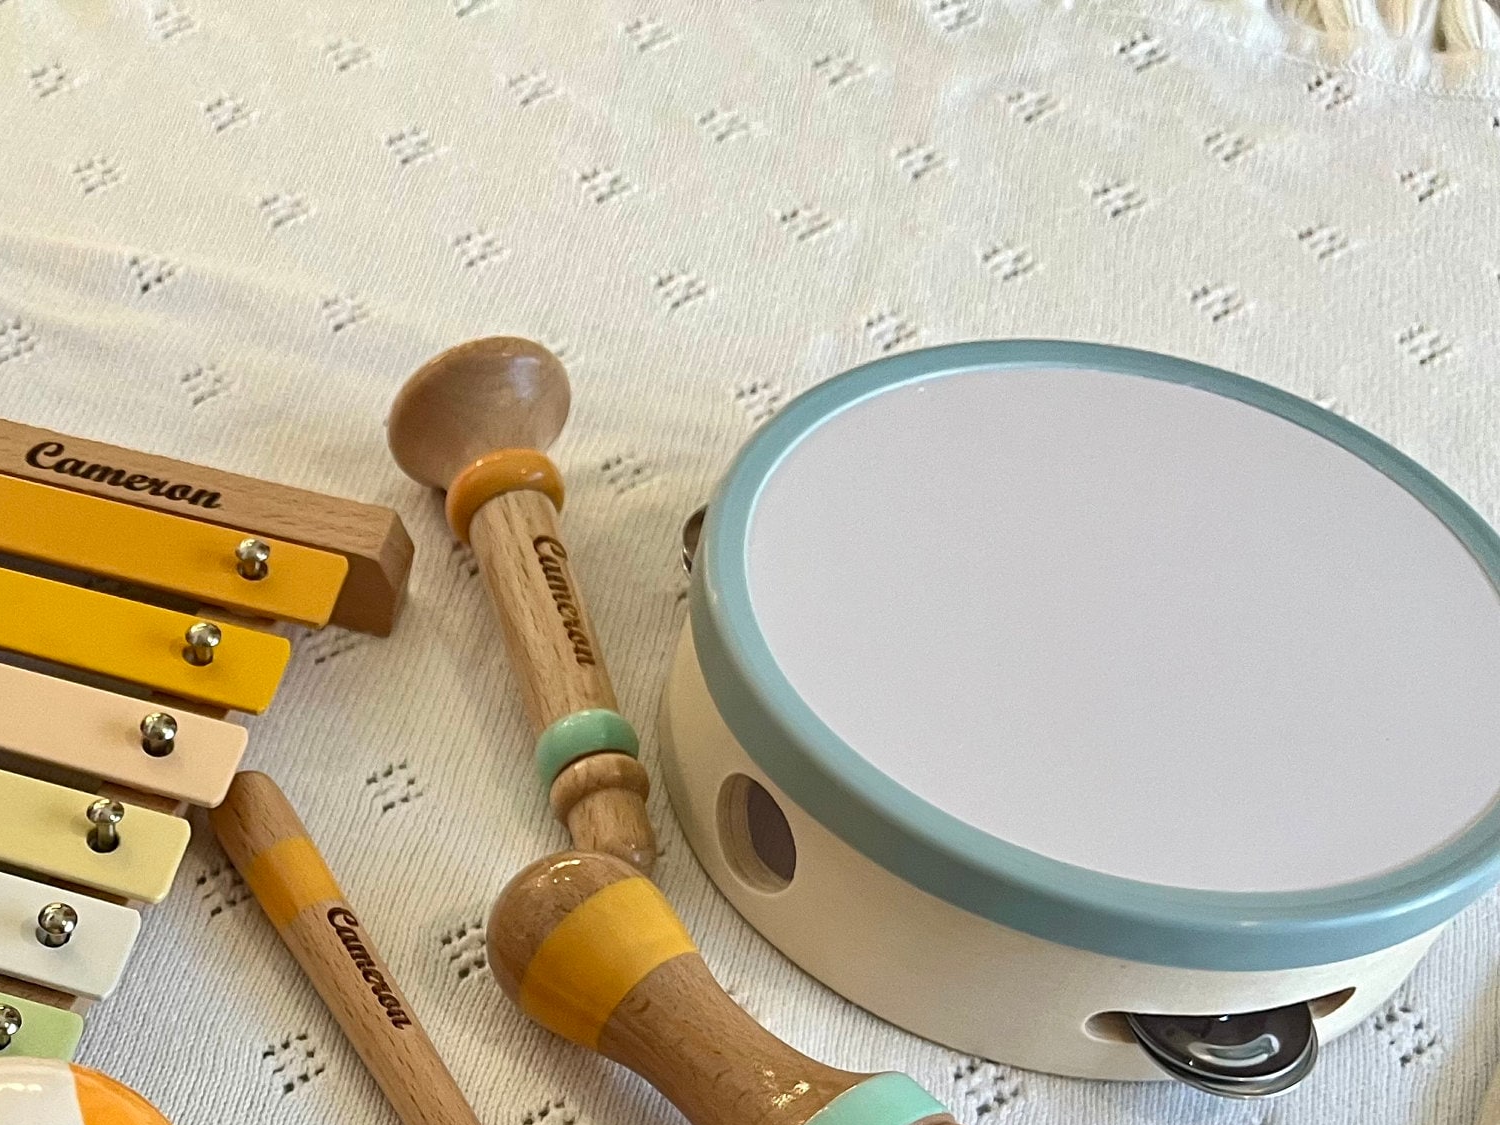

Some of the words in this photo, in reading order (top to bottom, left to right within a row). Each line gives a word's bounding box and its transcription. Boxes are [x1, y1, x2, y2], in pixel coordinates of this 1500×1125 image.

[24, 440, 223, 509] Cameron
[532, 535, 597, 667] Cameron
[326, 906, 412, 1031] Cameron
